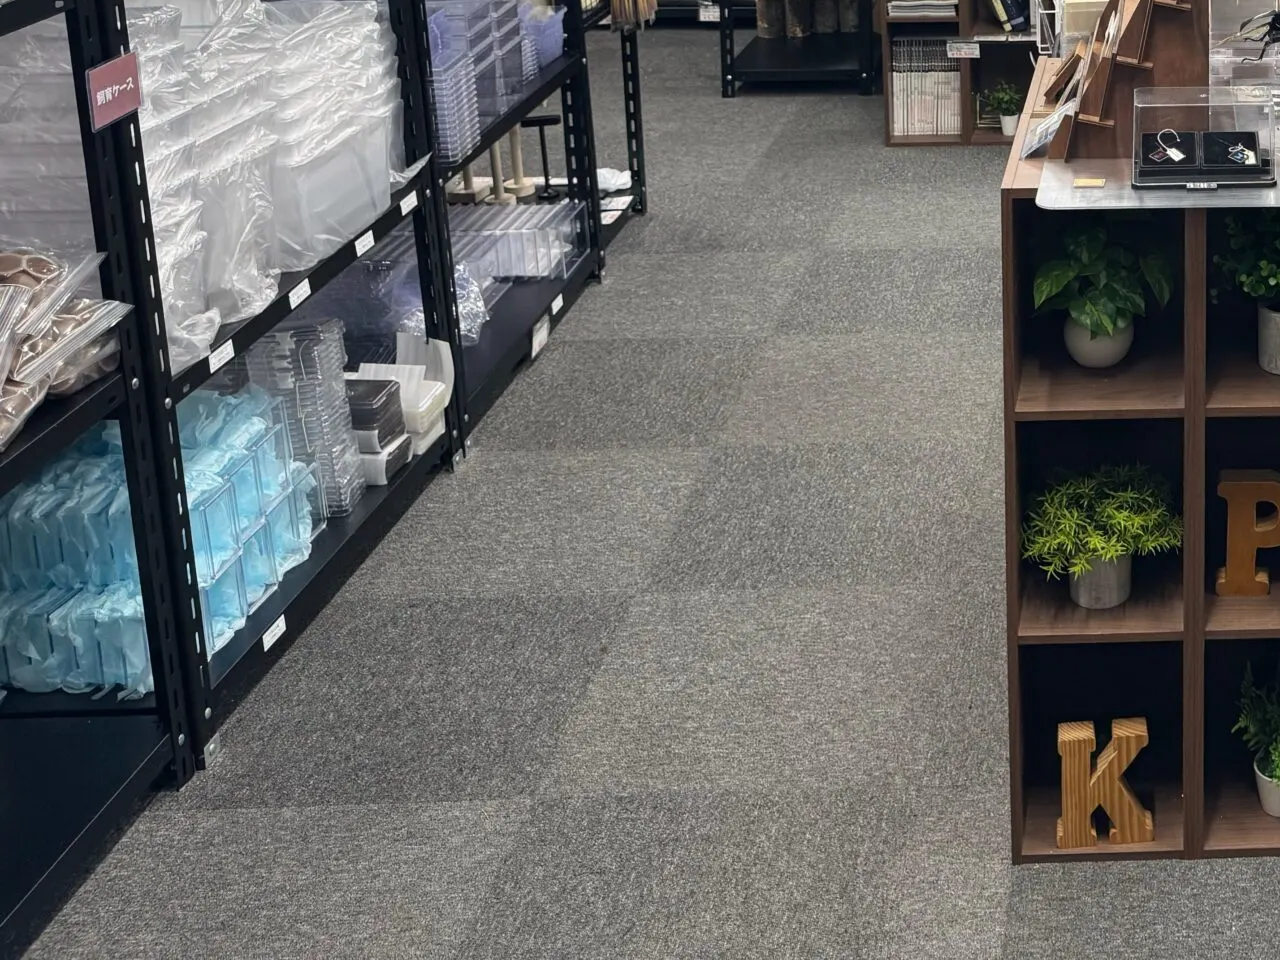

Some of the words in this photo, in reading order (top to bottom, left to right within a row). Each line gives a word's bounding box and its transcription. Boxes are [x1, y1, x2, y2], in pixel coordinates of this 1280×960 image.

[96, 77, 134, 106] 飼育ケース
[1056, 716, 1154, 849] K
